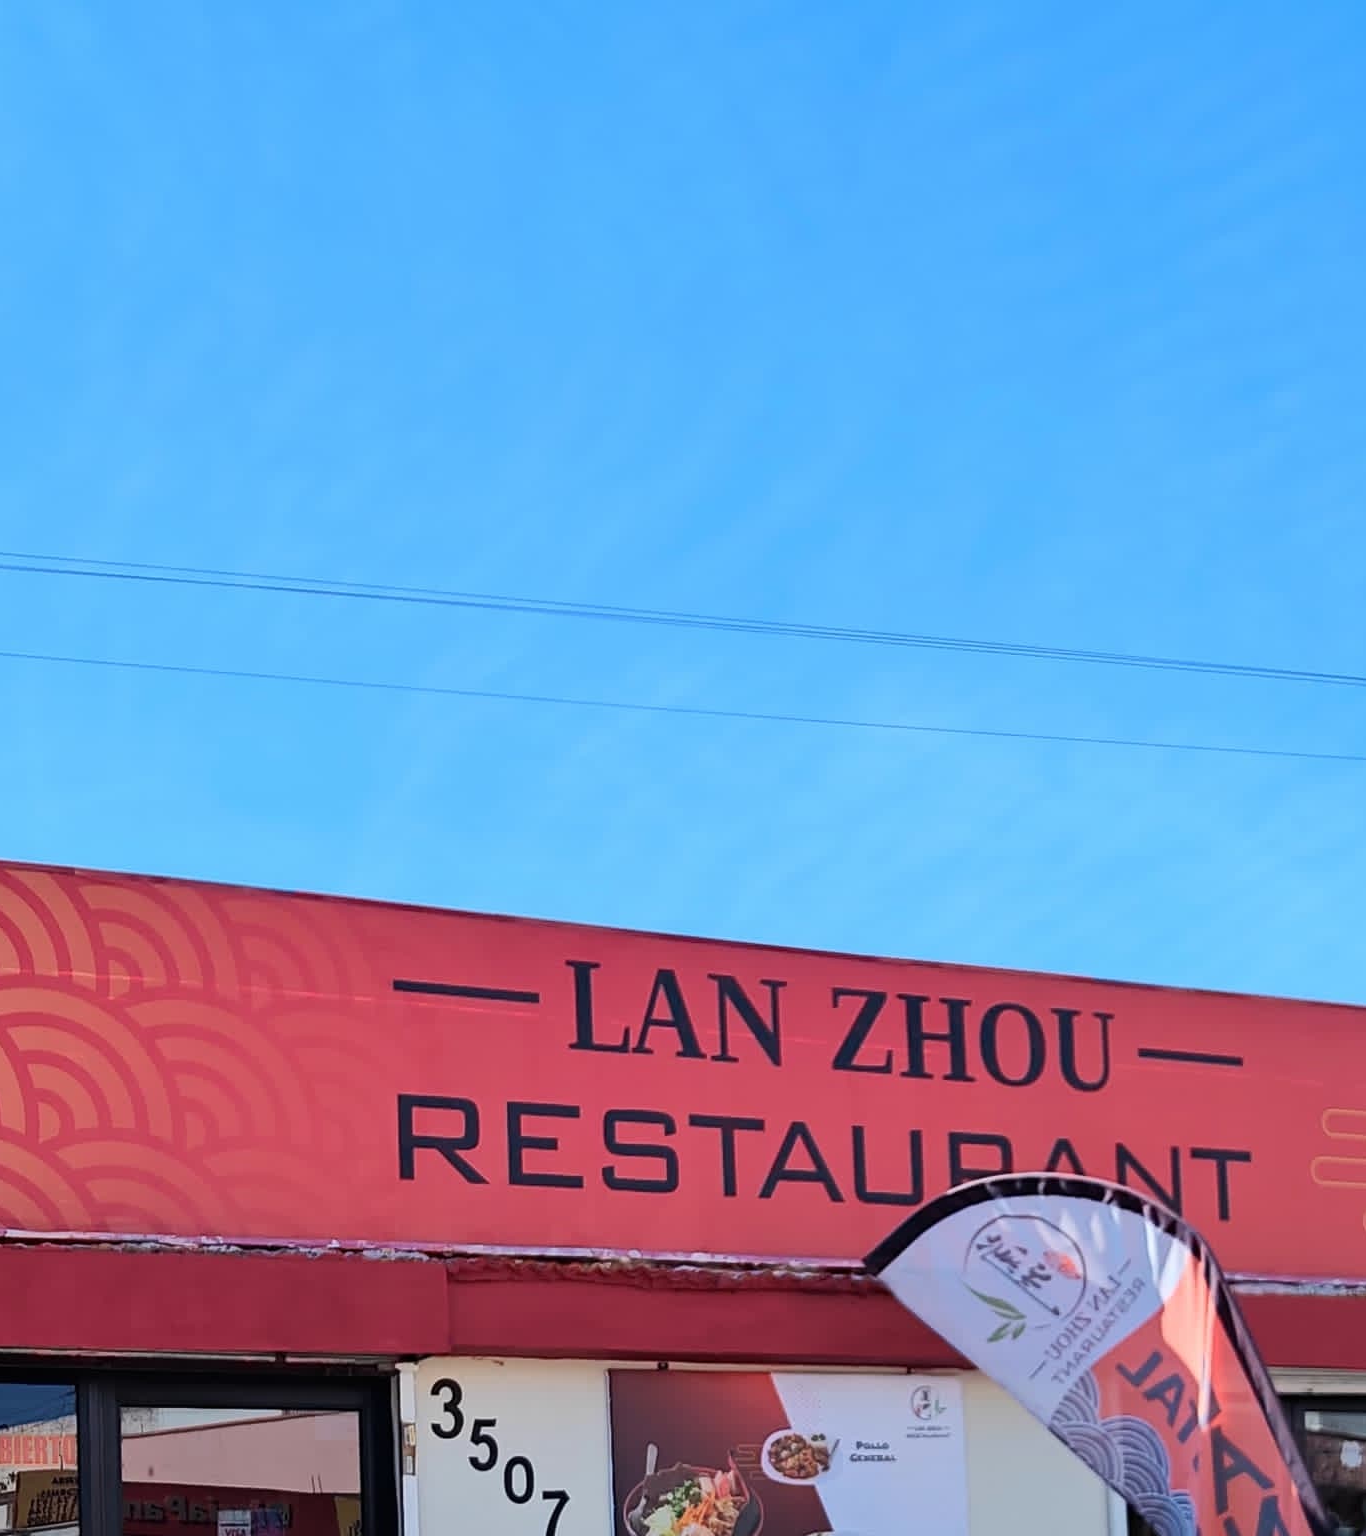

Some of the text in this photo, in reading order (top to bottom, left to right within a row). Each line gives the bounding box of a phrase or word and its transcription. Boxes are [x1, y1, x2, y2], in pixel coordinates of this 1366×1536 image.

[565, 959, 1115, 1093] LAN ZHOU
[430, 1379, 570, 1536] 3507
